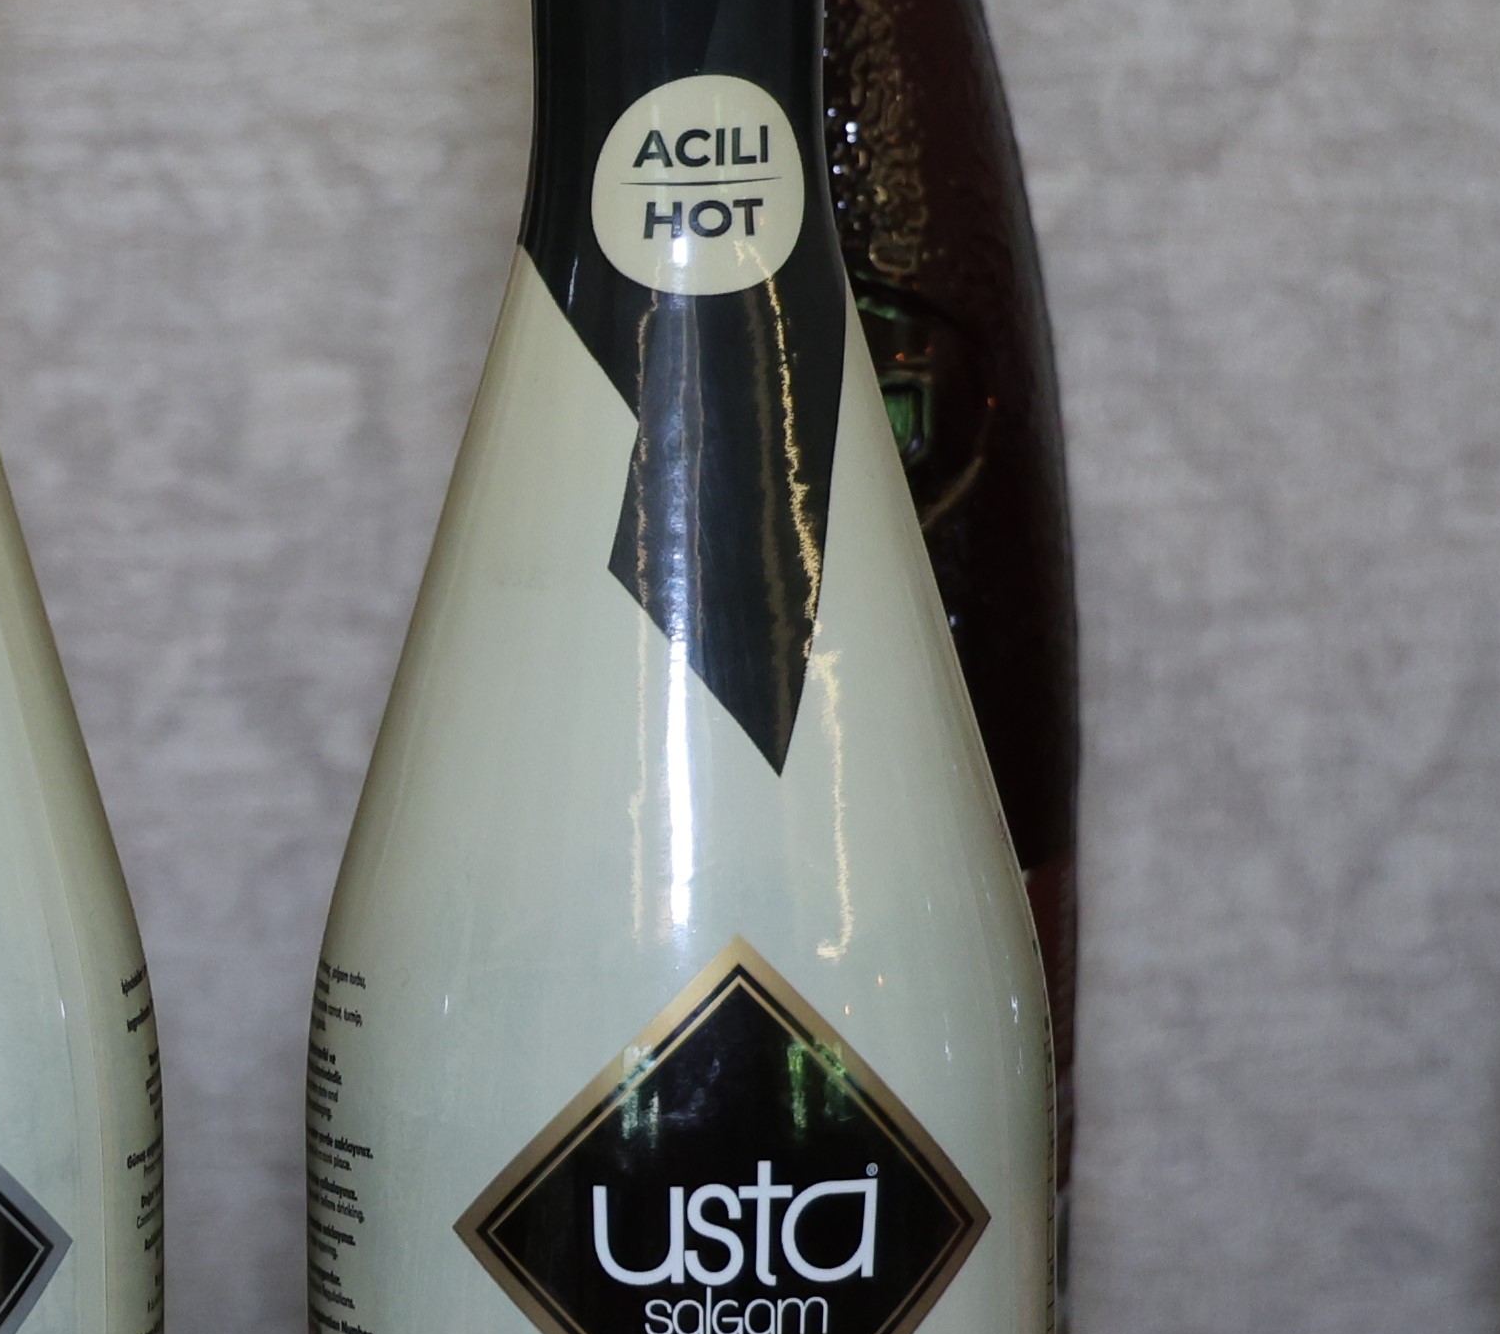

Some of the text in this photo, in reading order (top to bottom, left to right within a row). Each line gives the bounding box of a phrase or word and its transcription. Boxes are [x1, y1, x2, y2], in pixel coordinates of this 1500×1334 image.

[633, 125, 768, 167] ACILI
[644, 198, 764, 239] HOT
[592, 1160, 879, 1287] usta
